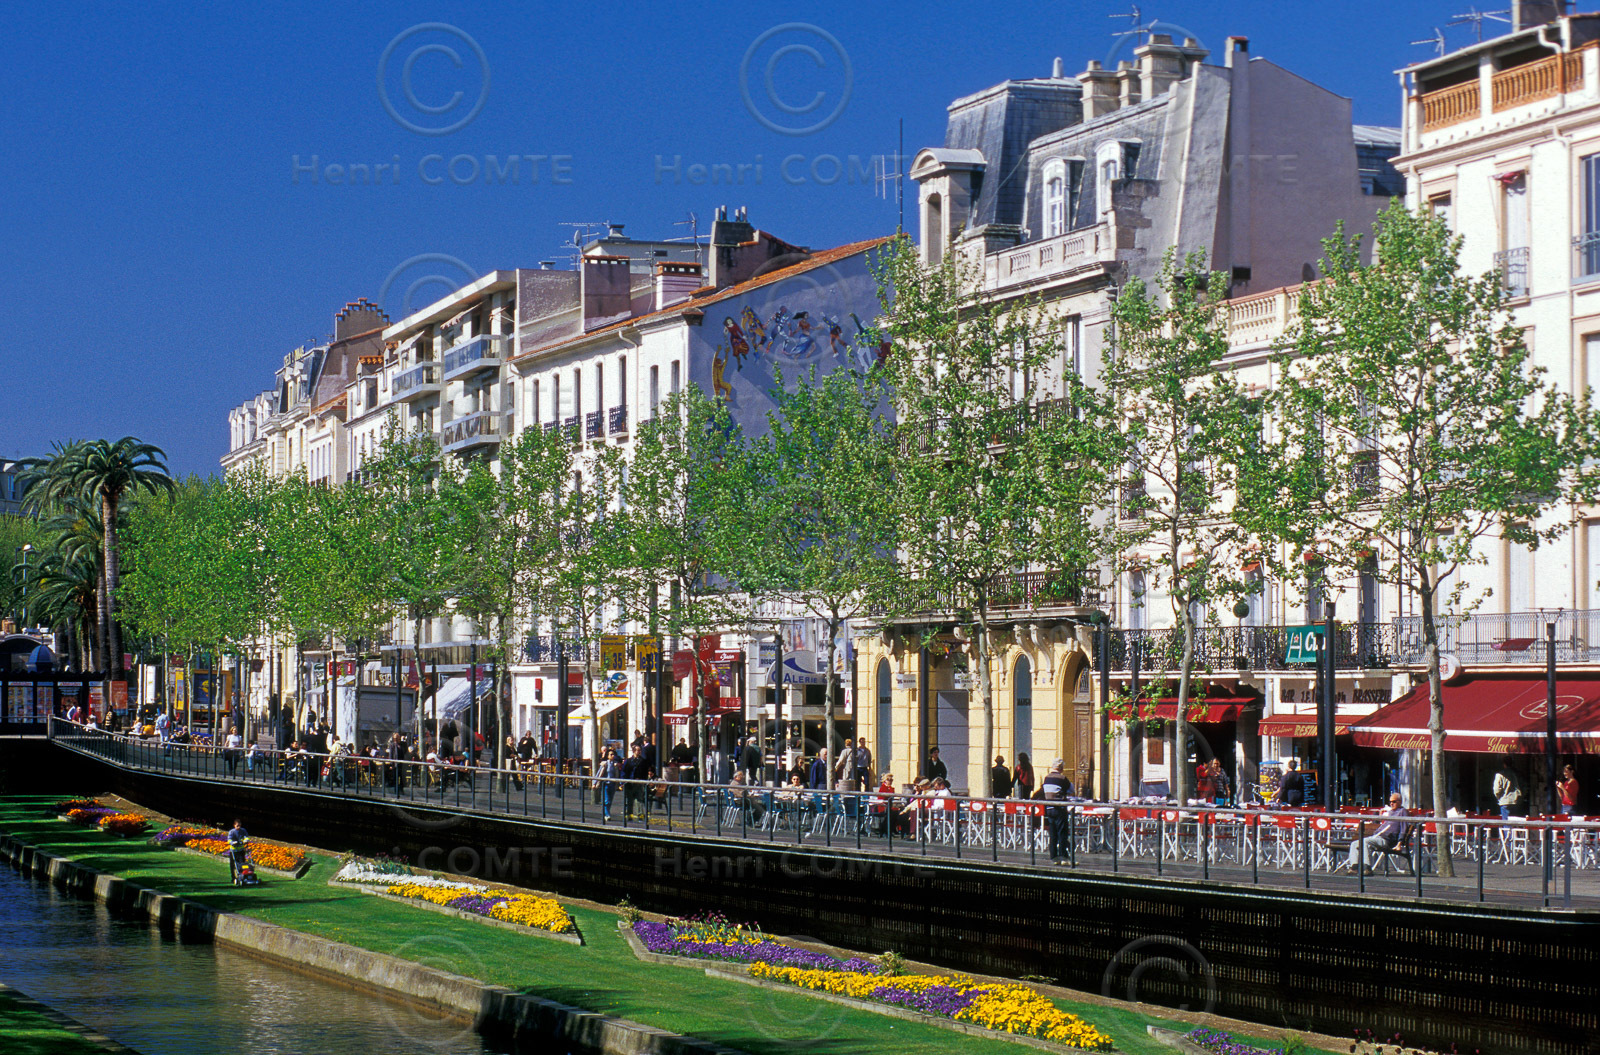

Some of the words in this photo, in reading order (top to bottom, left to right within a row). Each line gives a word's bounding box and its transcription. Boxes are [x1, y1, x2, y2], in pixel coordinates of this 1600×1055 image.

[612, 652, 623, 670] 35
[1281, 688, 1295, 704] BAR
[1382, 732, 1430, 751] Chocolatier
